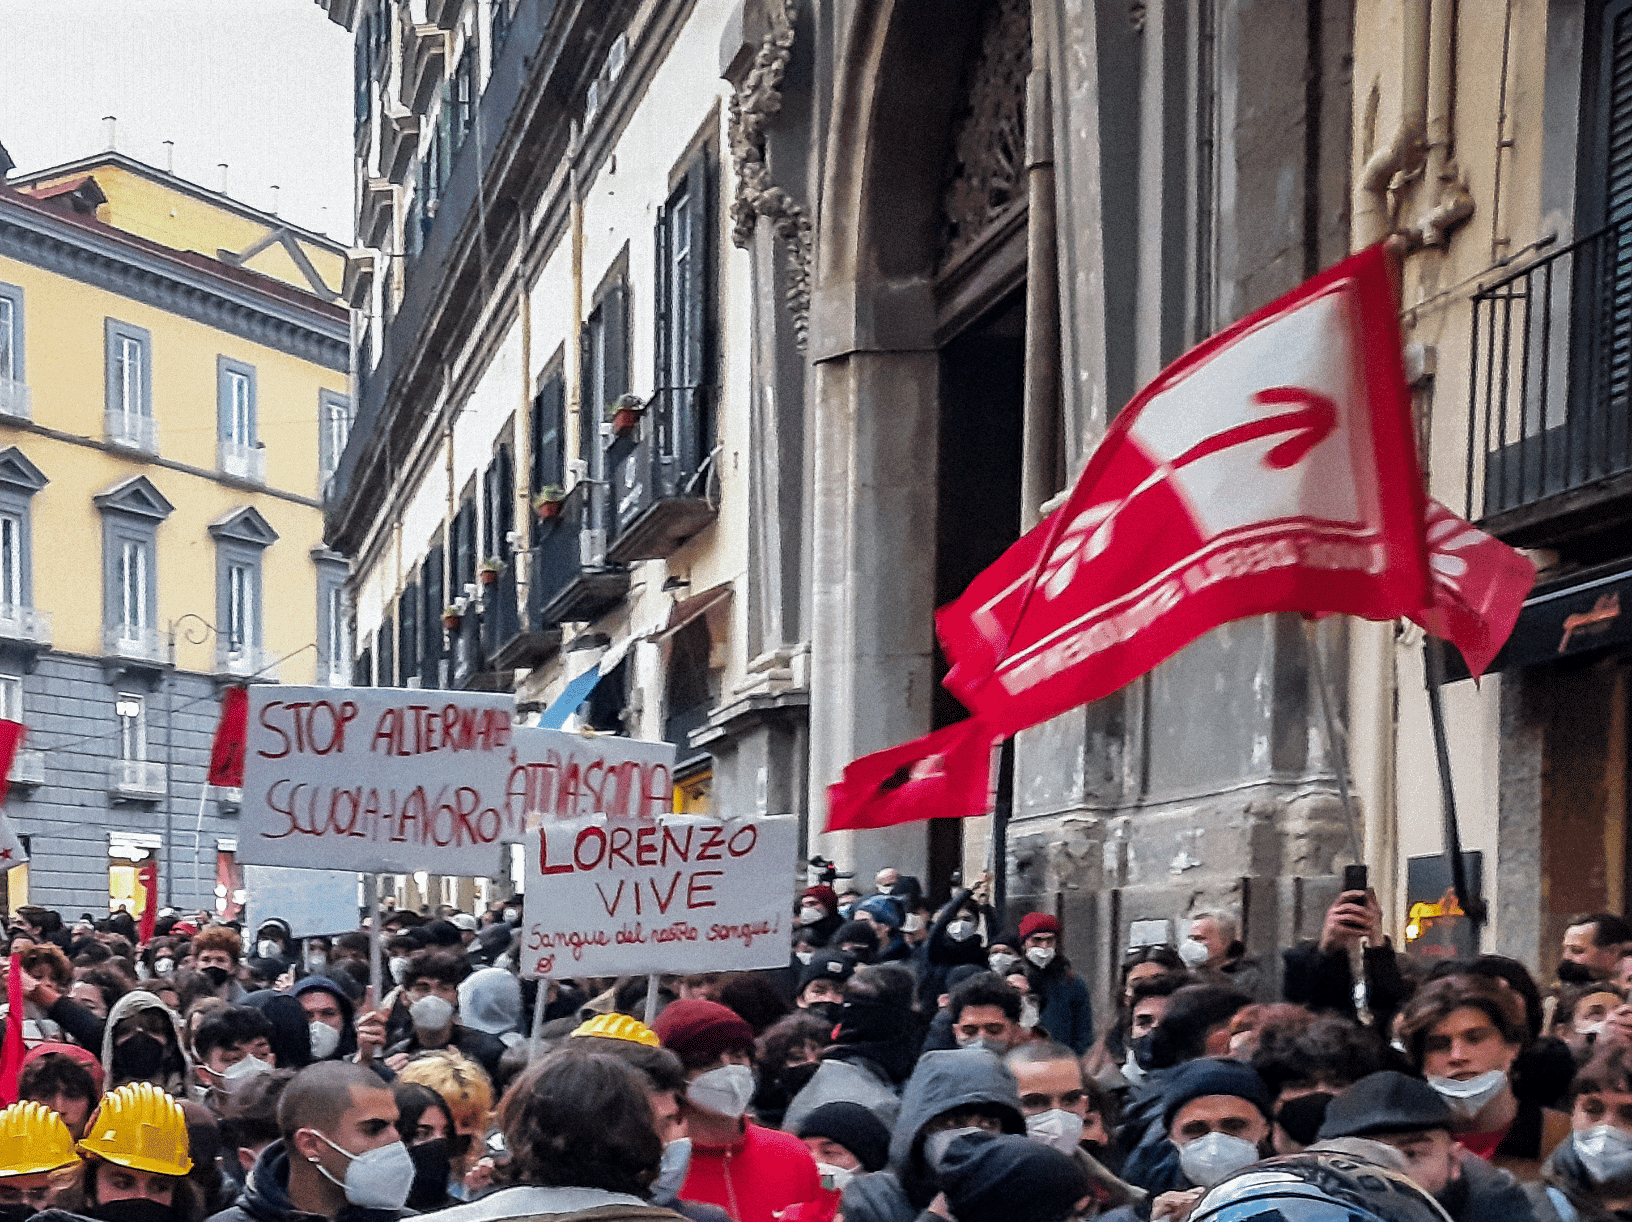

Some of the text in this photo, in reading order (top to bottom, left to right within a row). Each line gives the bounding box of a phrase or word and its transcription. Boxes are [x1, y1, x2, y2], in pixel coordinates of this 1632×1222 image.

[256, 701, 360, 758] STOP
[539, 823, 758, 876] LORENZO
[595, 870, 725, 918] VIVE
[528, 923, 610, 961] Sangue
[616, 921, 647, 945] del
